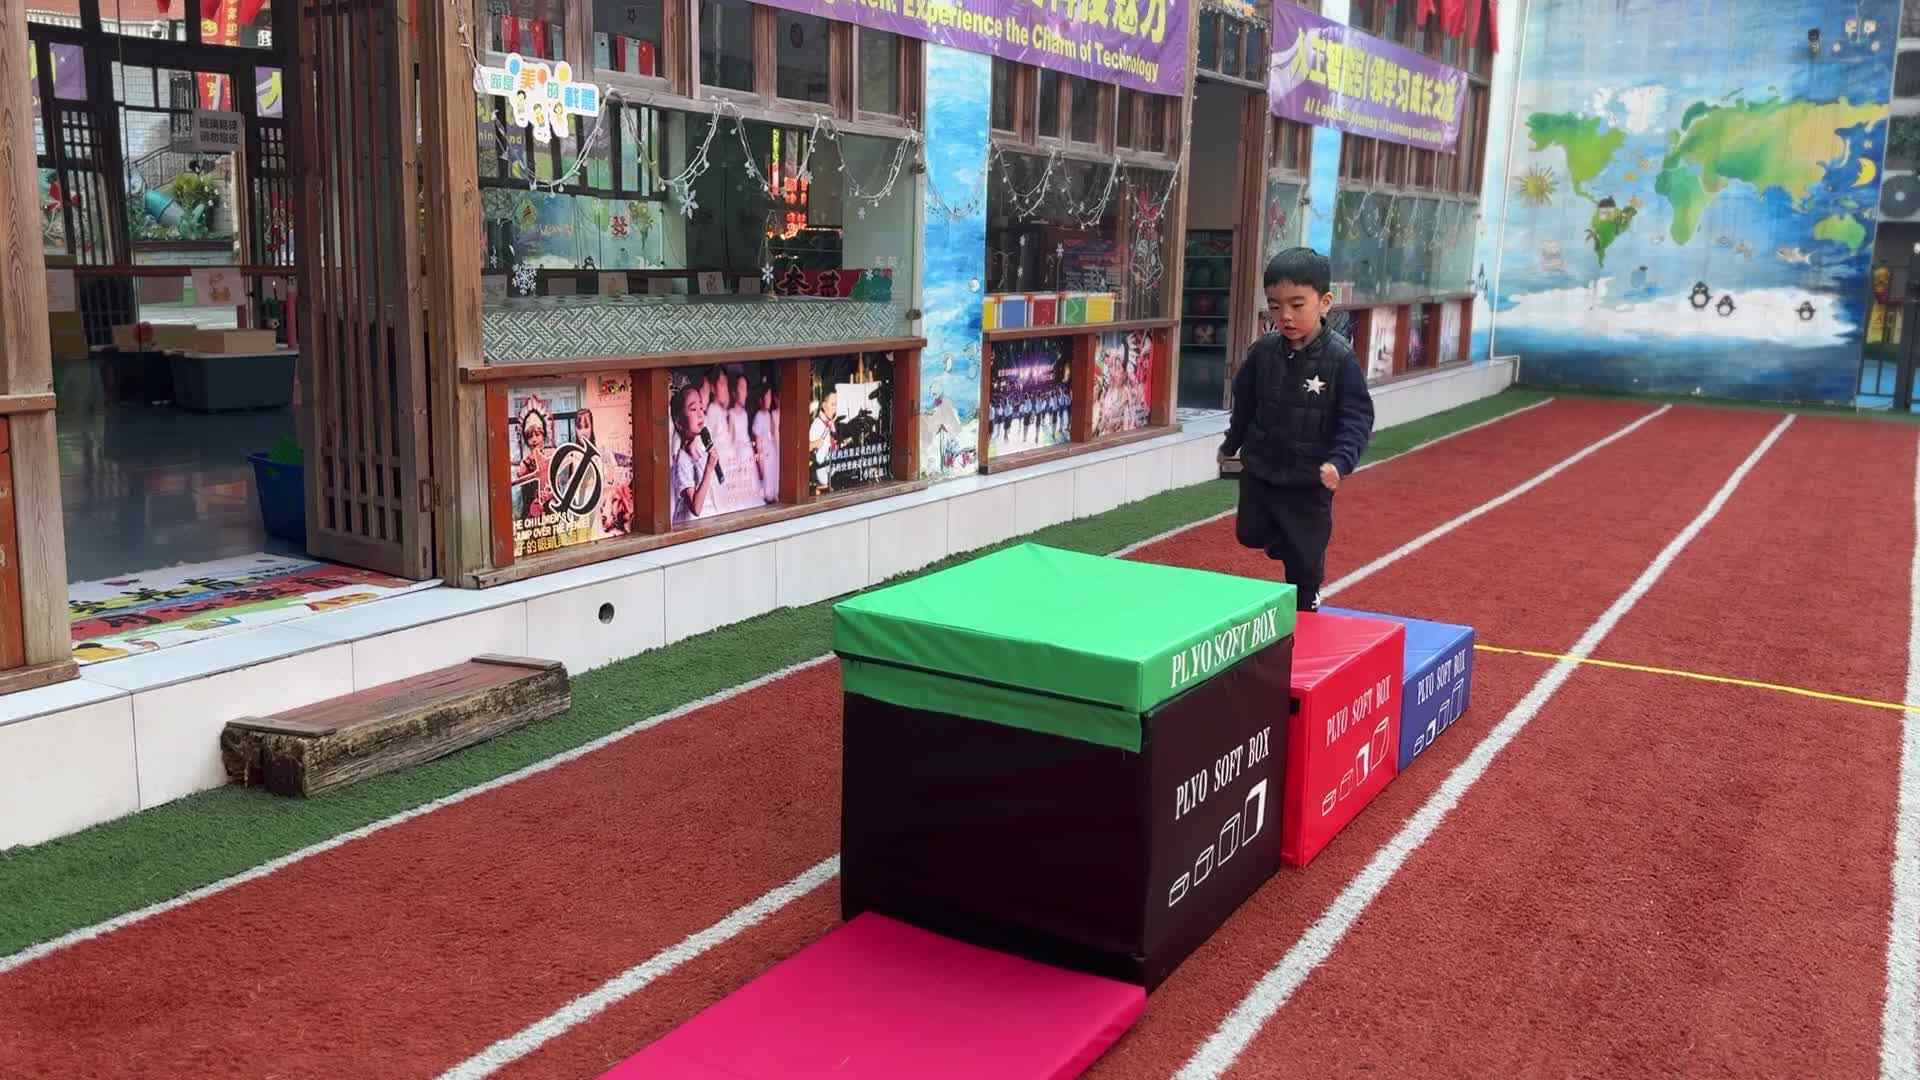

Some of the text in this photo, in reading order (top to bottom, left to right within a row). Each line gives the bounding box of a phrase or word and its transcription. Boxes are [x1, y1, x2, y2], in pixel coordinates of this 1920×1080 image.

[903, 0, 1002, 37] Experience
[1006, 17, 1028, 46] the
[1032, 24, 1077, 58] Charm
[1080, 41, 1092, 64] of
[1094, 43, 1160, 83] Technology
[1170, 606, 1277, 689] PLYO SOFT BOX
[1417, 648, 1467, 705] PLYO SOFT BOX
[1326, 674, 1392, 747] PLYO SOFT BOX
[1175, 725, 1272, 821] PLYO SOFT BOX
